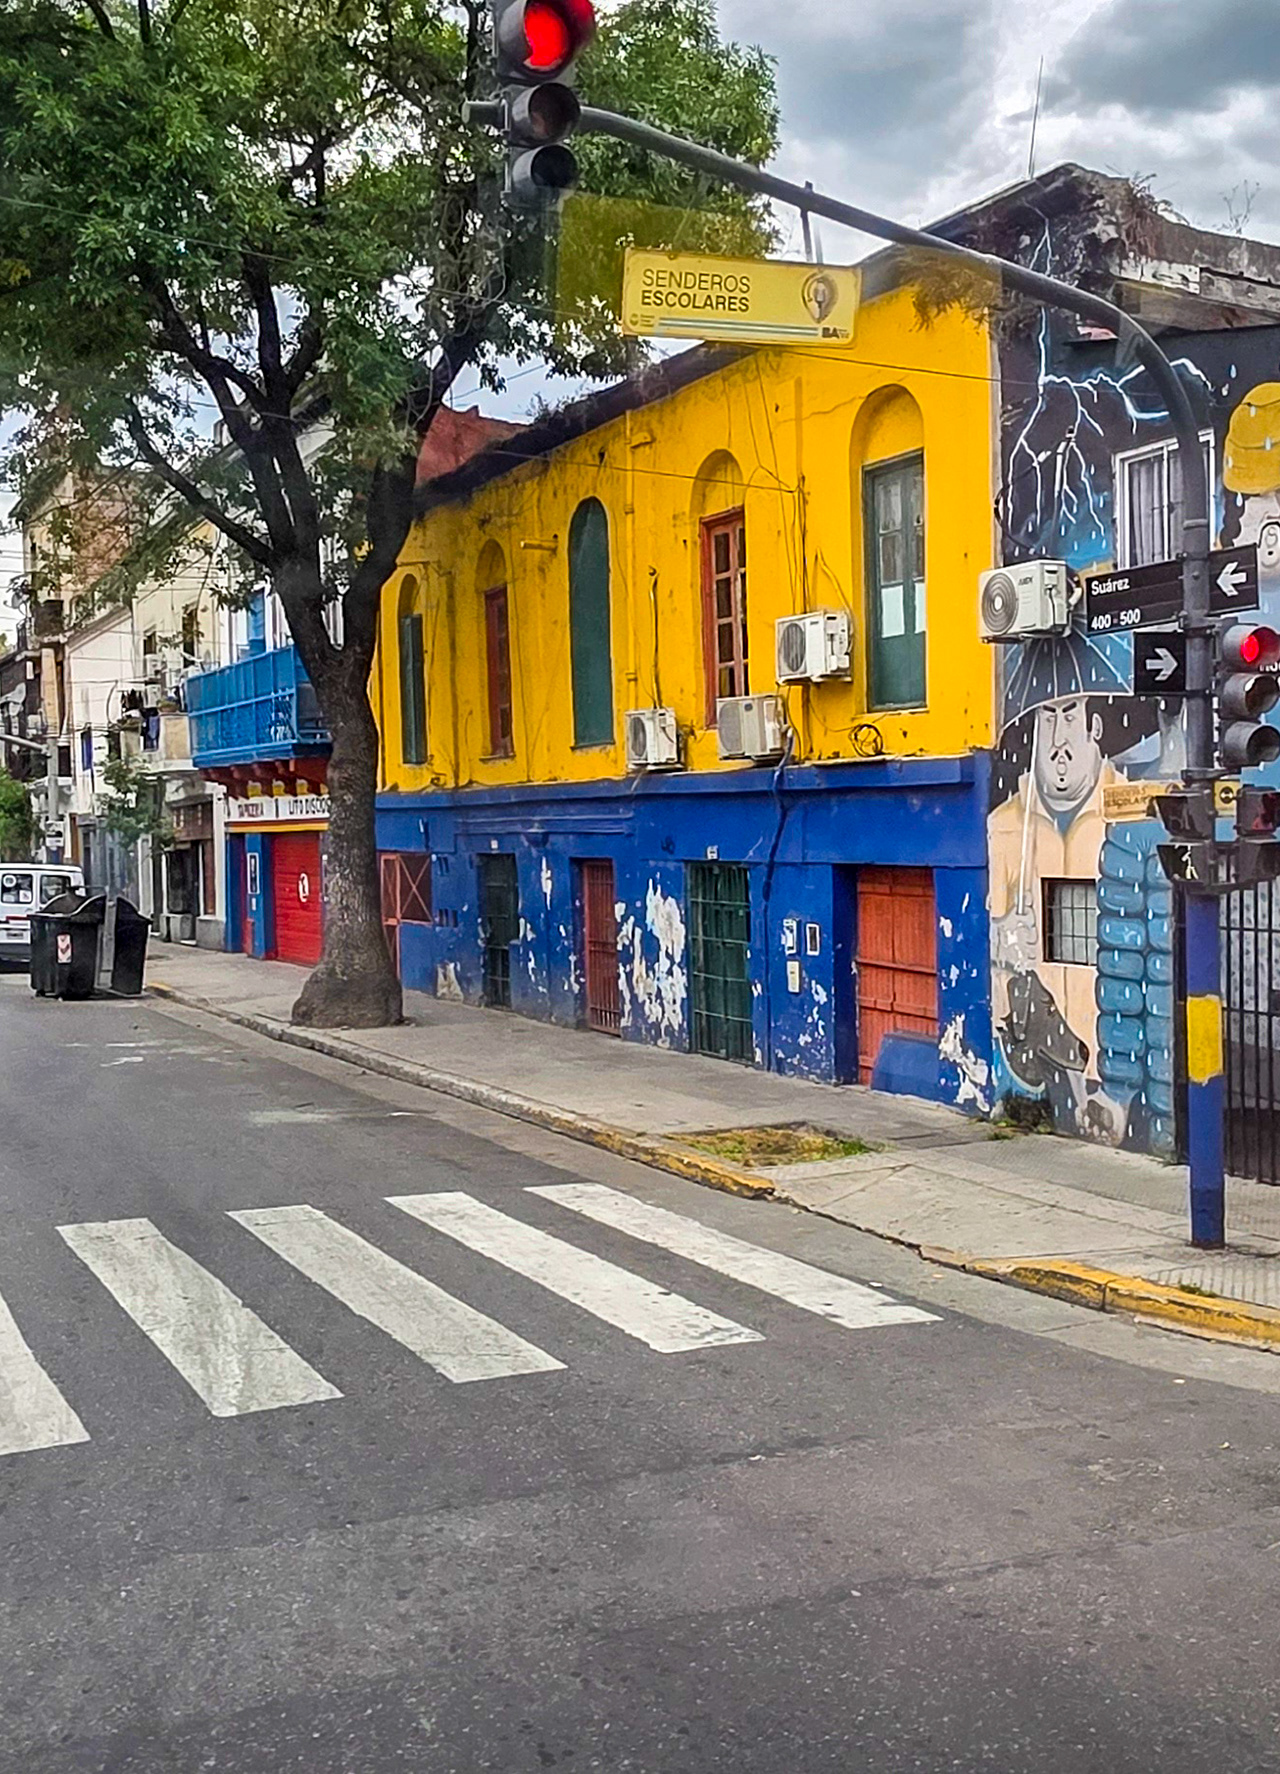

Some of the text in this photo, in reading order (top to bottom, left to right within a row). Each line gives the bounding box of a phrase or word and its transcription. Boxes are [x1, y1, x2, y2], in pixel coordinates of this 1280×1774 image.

[641, 268, 751, 293] SENDEROS
[641, 290, 751, 312] ESCOLARES
[1091, 576, 1131, 596] Suárez
[1091, 614, 1112, 630] 400
[1119, 608, 1141, 626] 500
